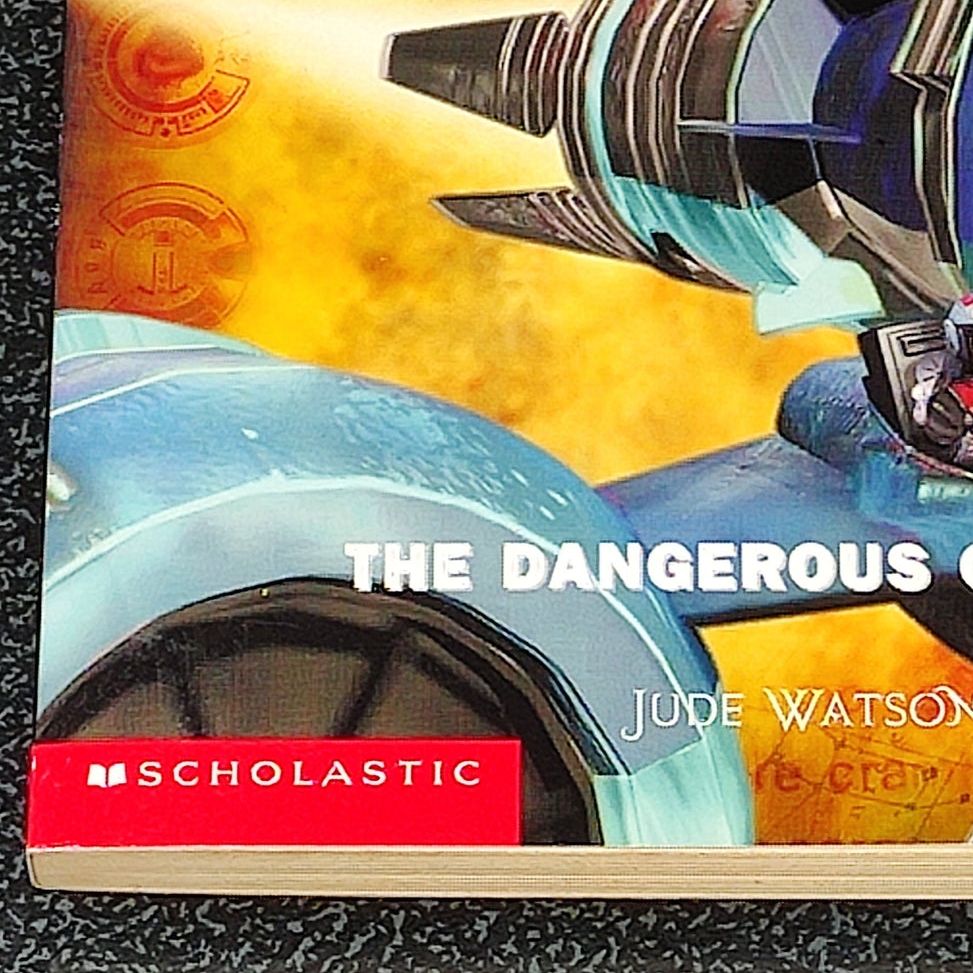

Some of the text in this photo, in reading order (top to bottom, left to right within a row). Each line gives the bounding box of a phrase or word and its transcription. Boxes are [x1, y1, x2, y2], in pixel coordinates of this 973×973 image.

[344, 540, 475, 594] THE
[502, 539, 935, 595] DANGEROUS
[620, 687, 747, 742] JUDE
[137, 759, 482, 788] SCHOLASTIC
